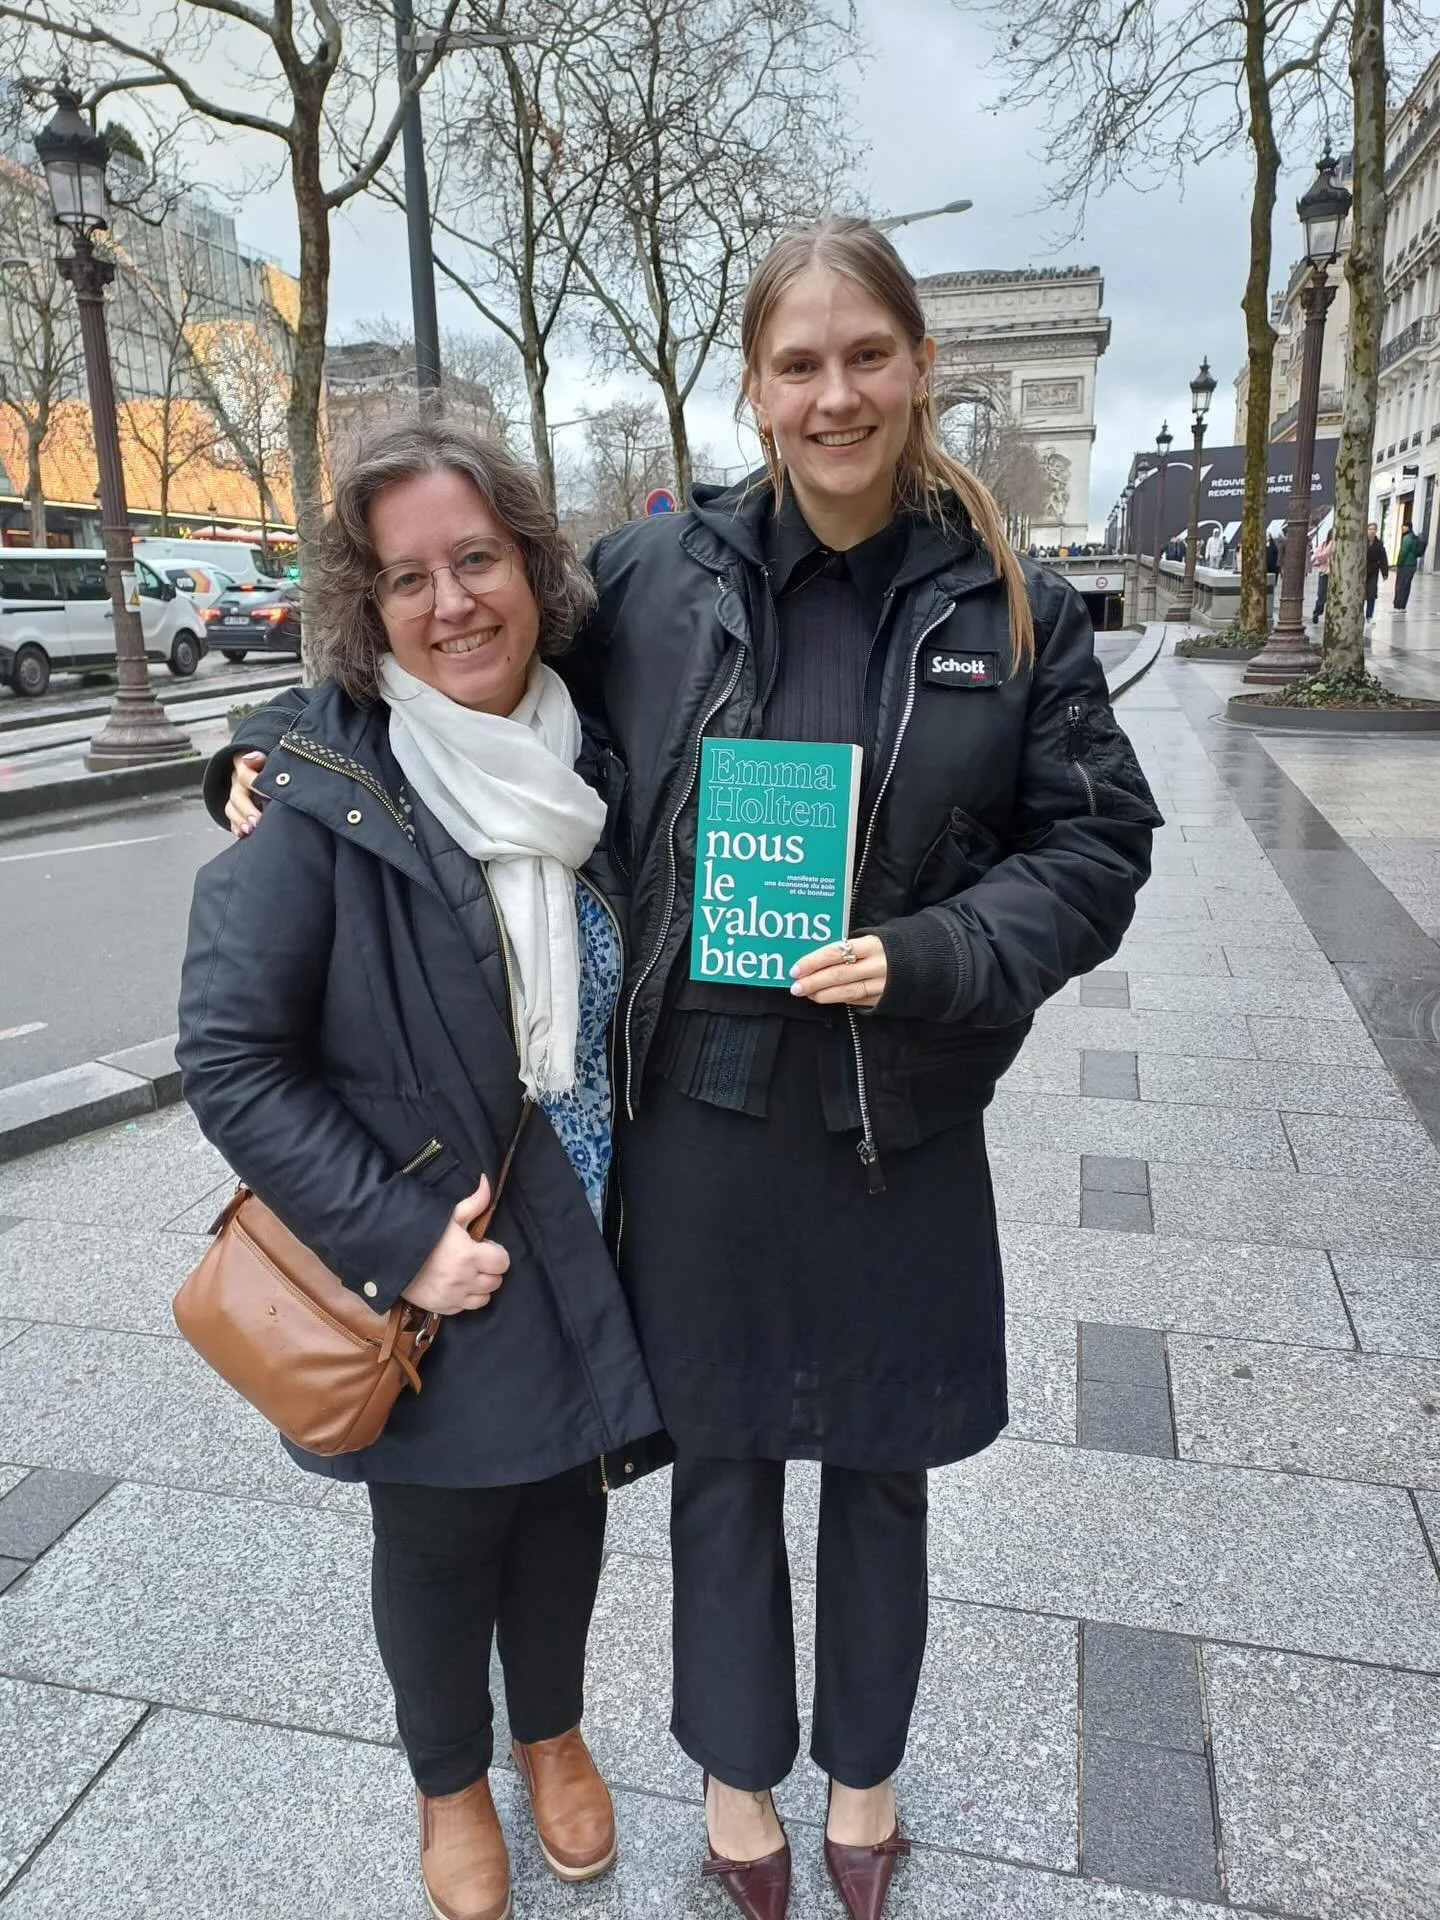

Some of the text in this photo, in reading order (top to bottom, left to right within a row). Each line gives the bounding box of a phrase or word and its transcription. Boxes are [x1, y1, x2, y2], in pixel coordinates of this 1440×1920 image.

[932, 655, 985, 674] Schott
[709, 748, 836, 790] Emma
[706, 786, 837, 828] Holten
[705, 830, 805, 864] nous
[702, 859, 735, 901] le
[807, 889, 835, 897] bonheur
[700, 896, 831, 941] valons
[699, 934, 786, 980] bien
